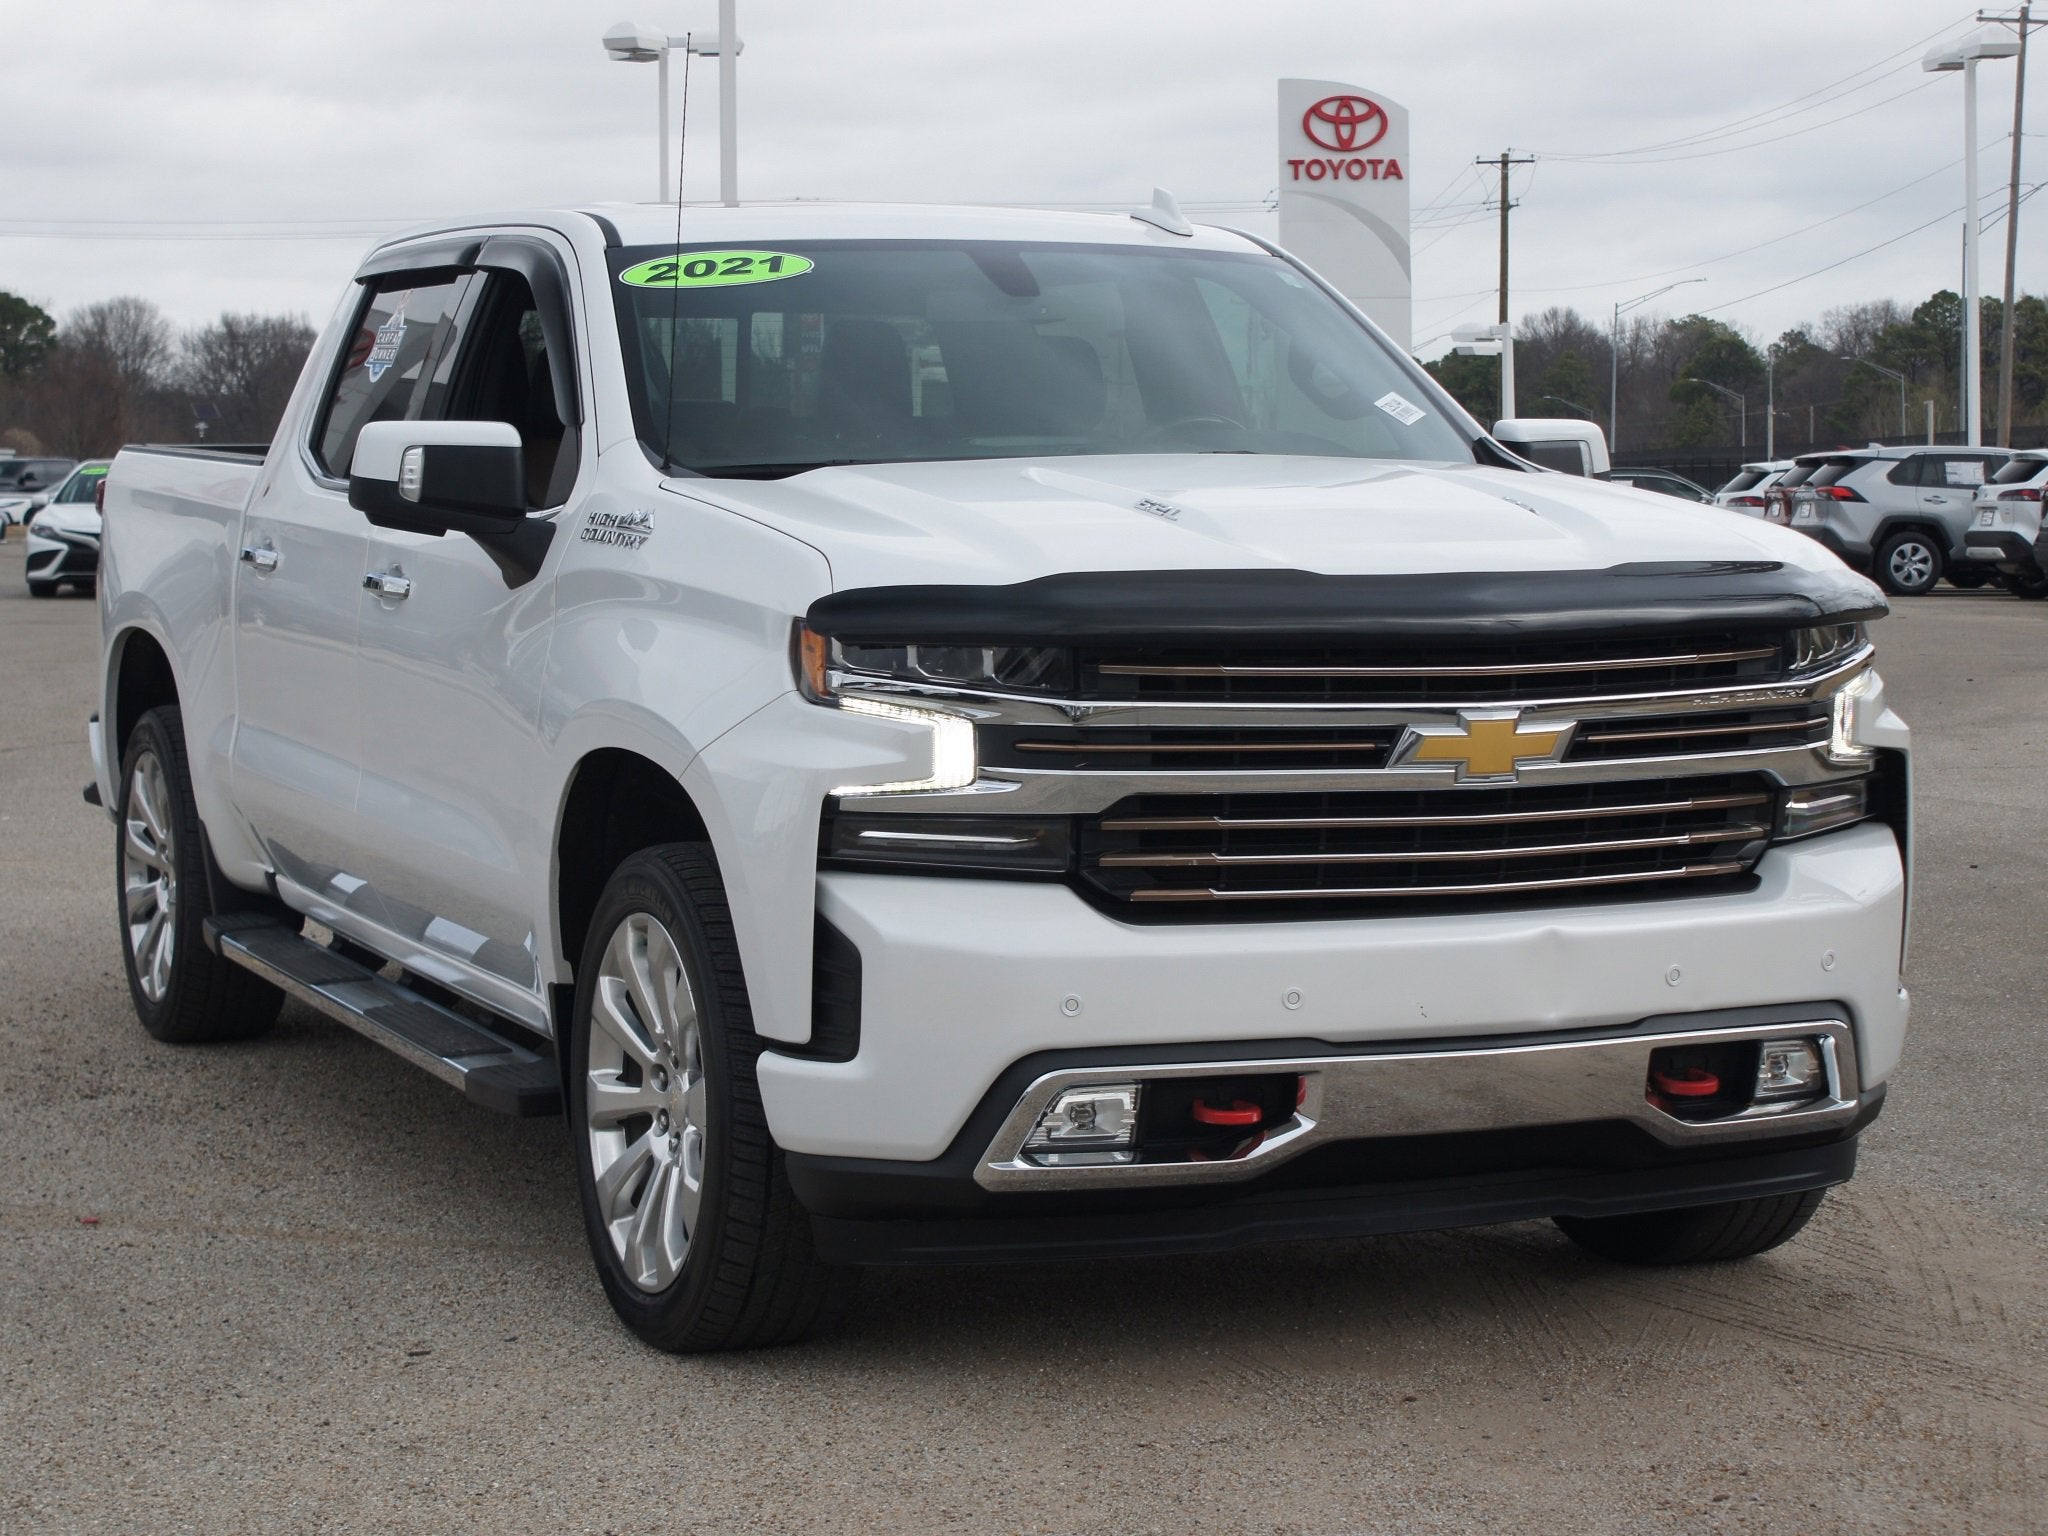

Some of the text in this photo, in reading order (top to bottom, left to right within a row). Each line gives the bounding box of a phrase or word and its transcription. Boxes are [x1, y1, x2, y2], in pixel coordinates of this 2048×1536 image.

[1287, 158, 1404, 181] TOYOTA
[643, 255, 786, 284] 2021
[587, 511, 621, 527] HIGH
[580, 527, 649, 550] COUNTRY
